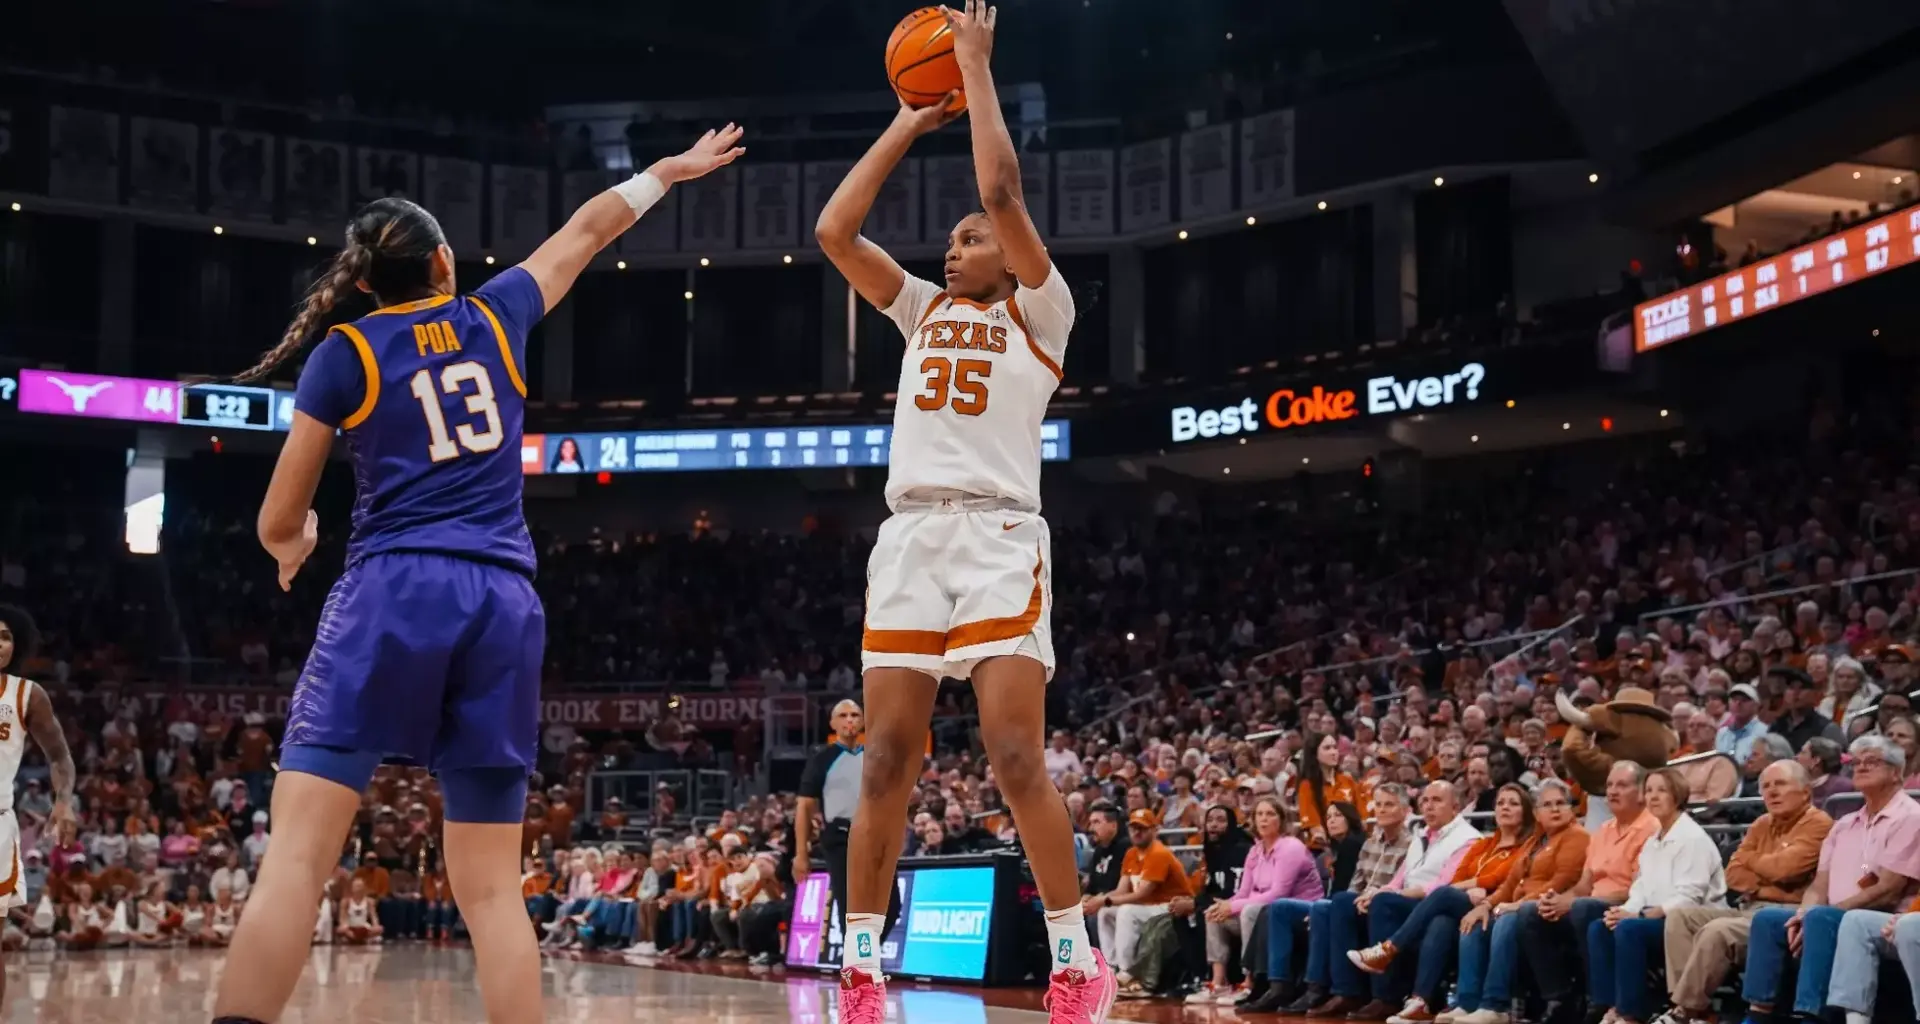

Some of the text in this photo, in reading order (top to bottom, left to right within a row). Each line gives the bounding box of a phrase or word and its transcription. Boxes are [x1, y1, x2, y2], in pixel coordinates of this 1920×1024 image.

[412, 320, 462, 357] POA
[918, 320, 1007, 354] TEXAS
[142, 386, 174, 415] 44
[914, 356, 992, 416] 35
[1171, 362, 1485, 442] Best Coke Ever?
[410, 360, 504, 463] 13
[600, 437, 627, 468] 24
[942, 909, 986, 935] LIGHT
